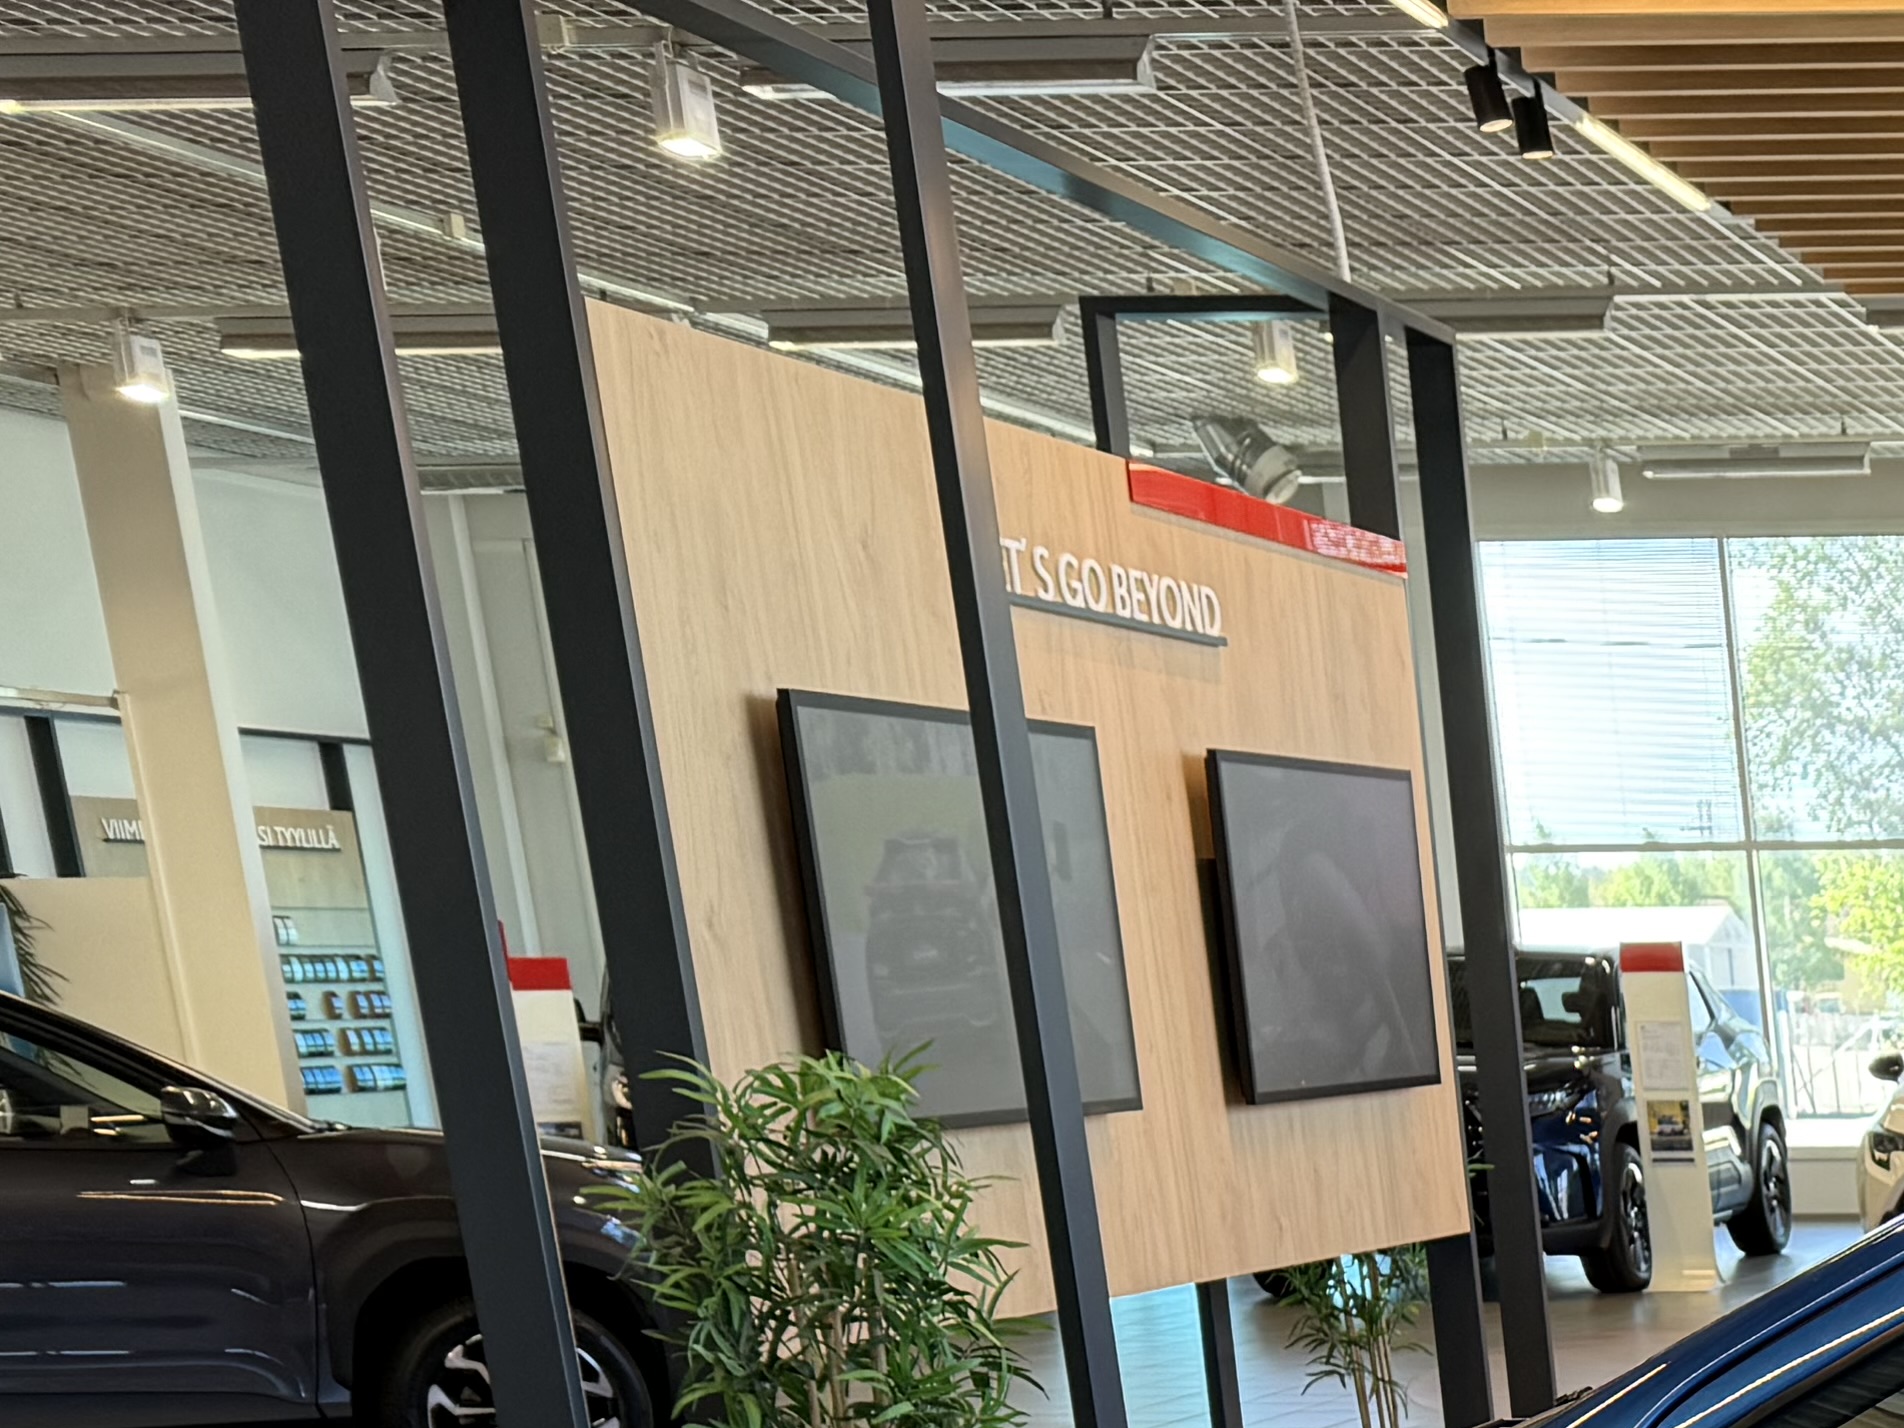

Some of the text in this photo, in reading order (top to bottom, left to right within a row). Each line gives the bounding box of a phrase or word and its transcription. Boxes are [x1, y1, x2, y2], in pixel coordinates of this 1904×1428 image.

[1000, 537, 1222, 636] T'S GO BEYOND
